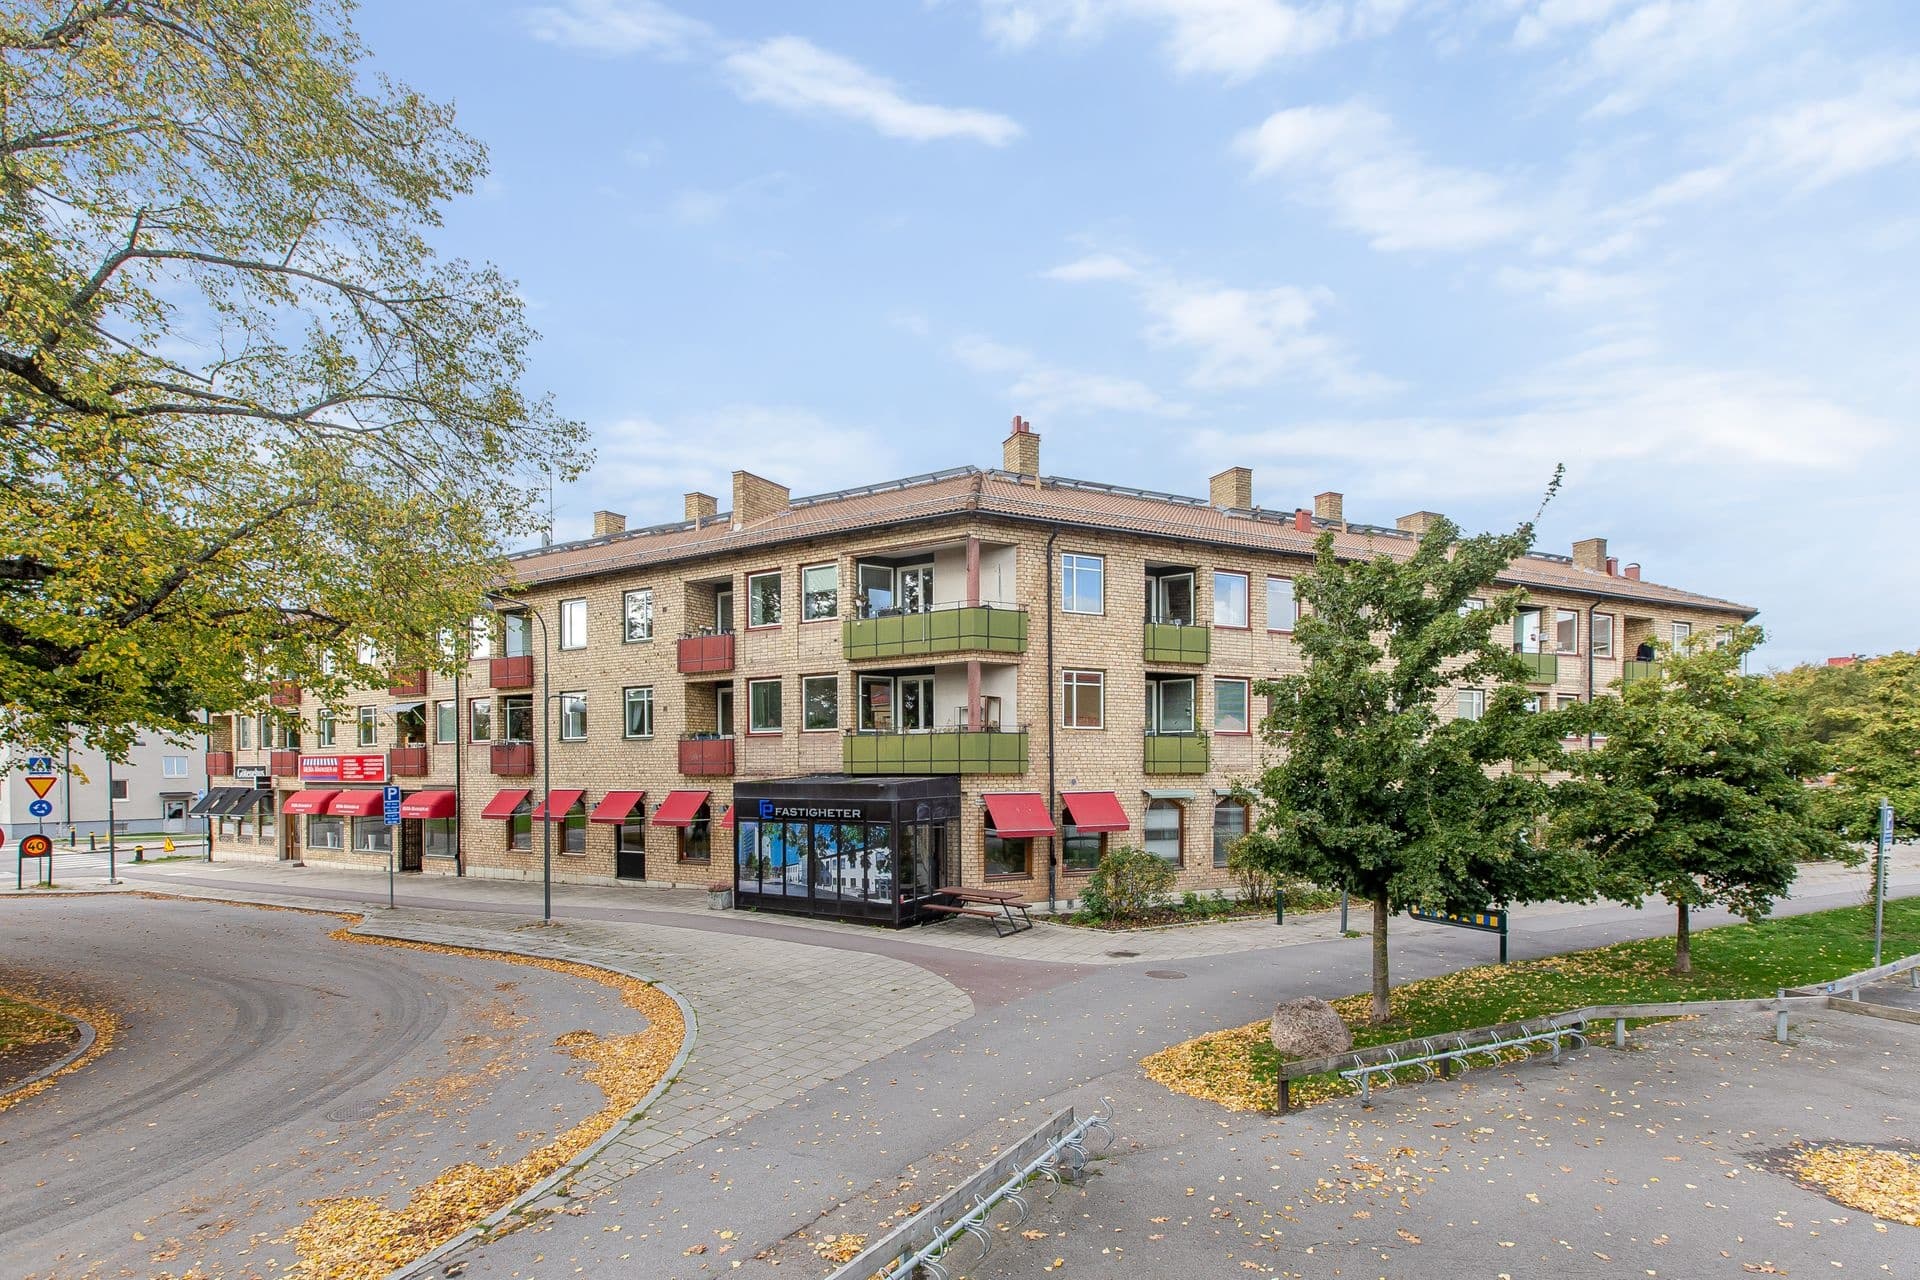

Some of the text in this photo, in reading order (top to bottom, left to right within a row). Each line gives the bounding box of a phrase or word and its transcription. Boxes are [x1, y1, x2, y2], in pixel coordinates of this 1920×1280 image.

[387, 787, 398, 801] P
[775, 807, 861, 818] FASTIGHETER
[28, 841, 44, 851] 40
